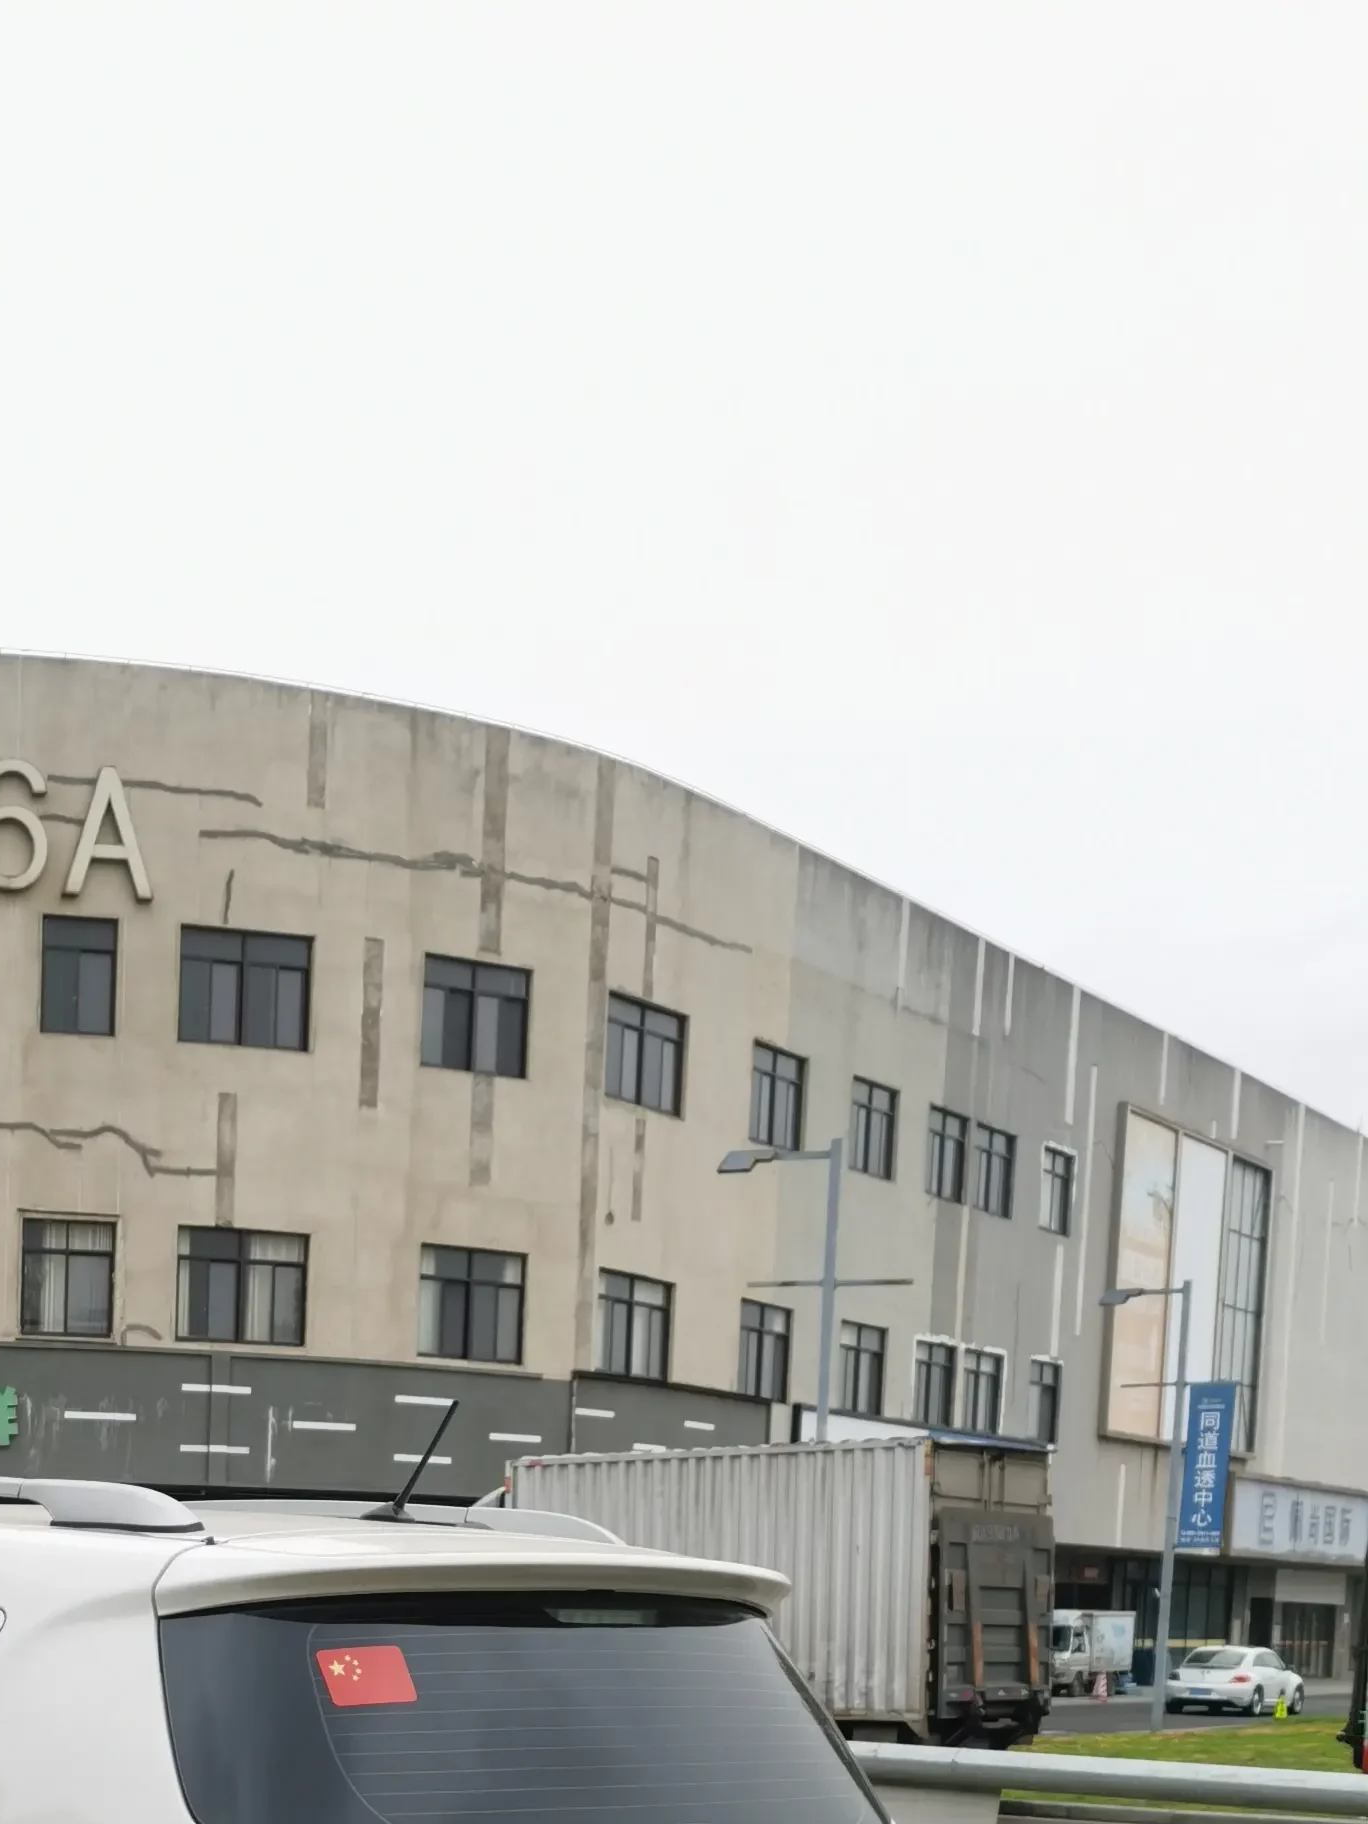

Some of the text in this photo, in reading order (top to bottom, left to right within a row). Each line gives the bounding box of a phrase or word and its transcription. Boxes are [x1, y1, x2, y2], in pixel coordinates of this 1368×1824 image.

[1191, 1411, 1221, 1527] 同道血透中心
